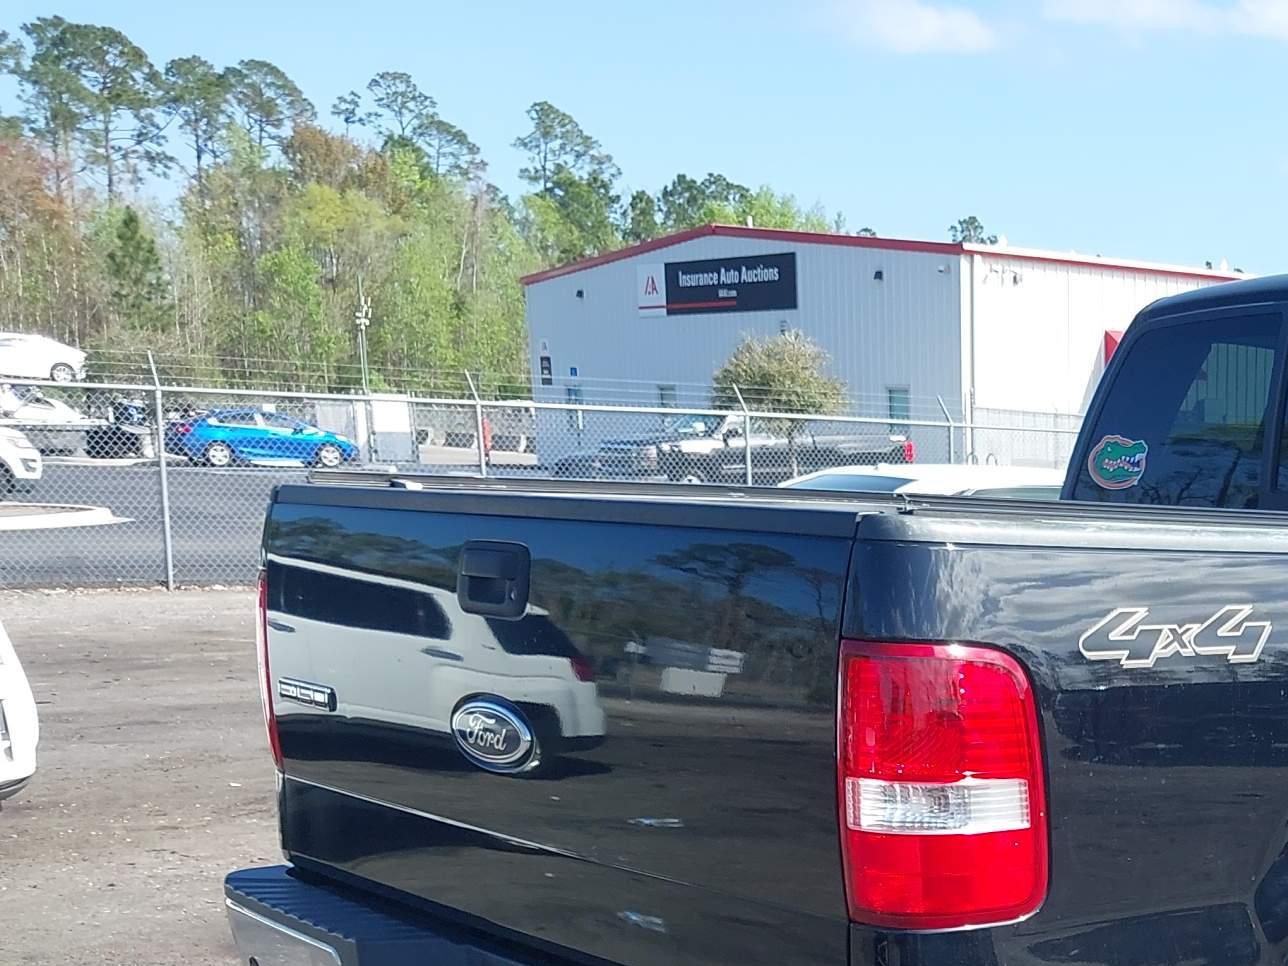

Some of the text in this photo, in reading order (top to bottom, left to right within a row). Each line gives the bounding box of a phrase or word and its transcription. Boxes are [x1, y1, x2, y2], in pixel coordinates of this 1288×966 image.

[678, 264, 780, 287] Insurance Auto Auctions
[1079, 604, 1273, 669] 4x4
[467, 712, 507, 751] Ford
